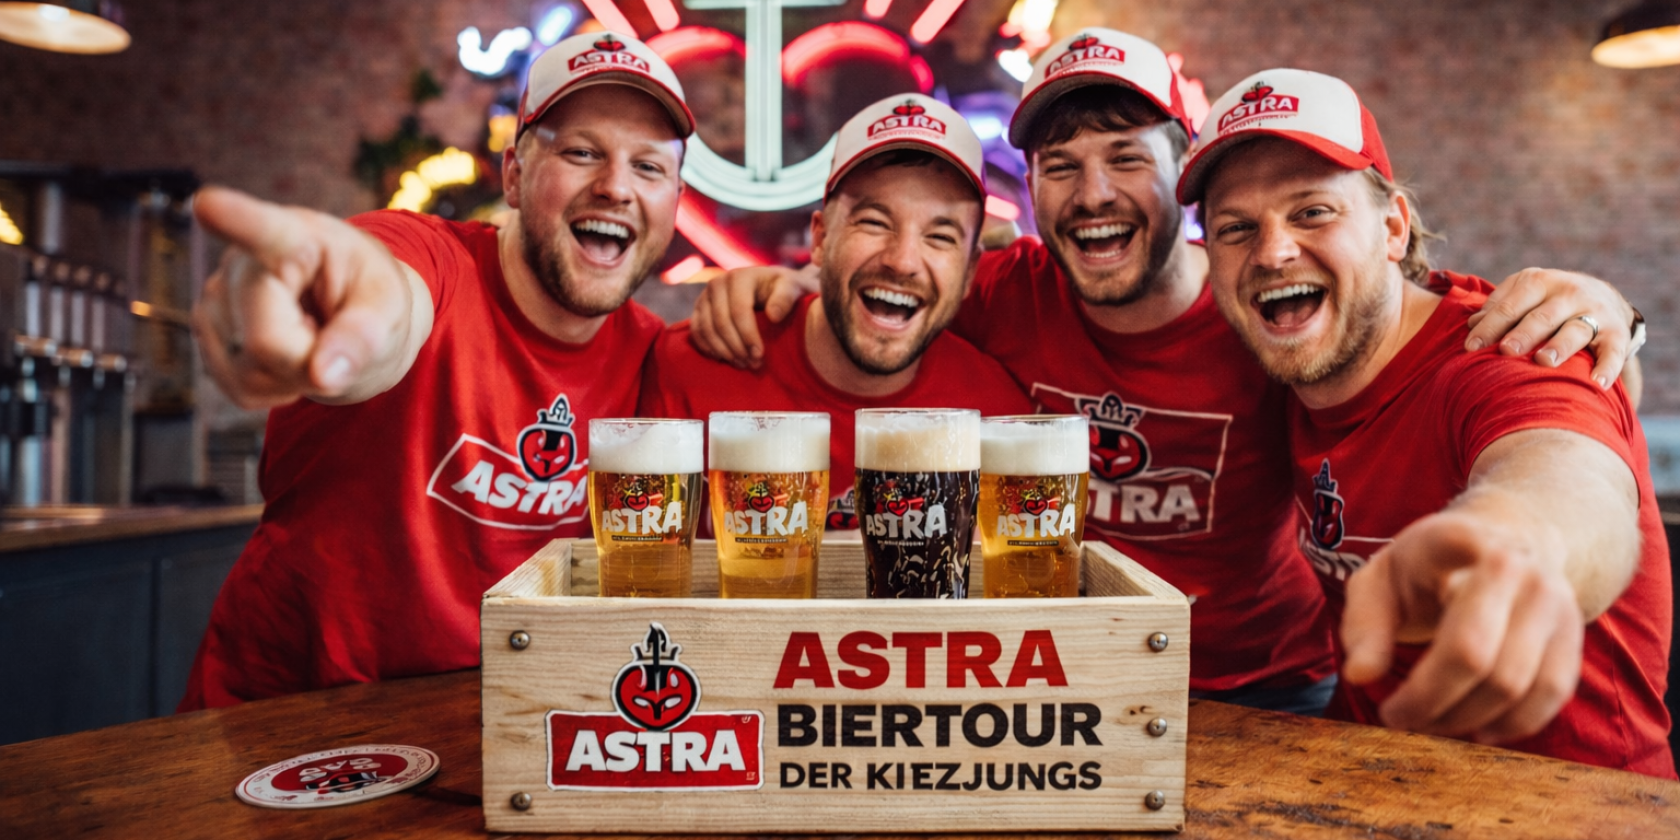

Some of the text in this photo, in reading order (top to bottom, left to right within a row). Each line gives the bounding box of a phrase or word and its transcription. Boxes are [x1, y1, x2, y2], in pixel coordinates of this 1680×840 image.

[574, 50, 646, 69] ASTRA
[1050, 46, 1119, 74] ASTRA
[873, 115, 942, 133] ASTRA
[1222, 96, 1293, 128] ASTRA
[451, 460, 587, 515] ASTRA
[1086, 480, 1200, 523] TRA
[602, 501, 683, 534] ASTRA
[724, 501, 808, 536] ASTRA
[866, 504, 947, 539] ASTRA
[997, 503, 1076, 538] ASTRA
[772, 629, 1069, 690] ASTRA
[777, 702, 1103, 748] BIERTOUR
[565, 729, 746, 772] ASTRA
[779, 760, 1102, 791] DER KIEZJUNGS
